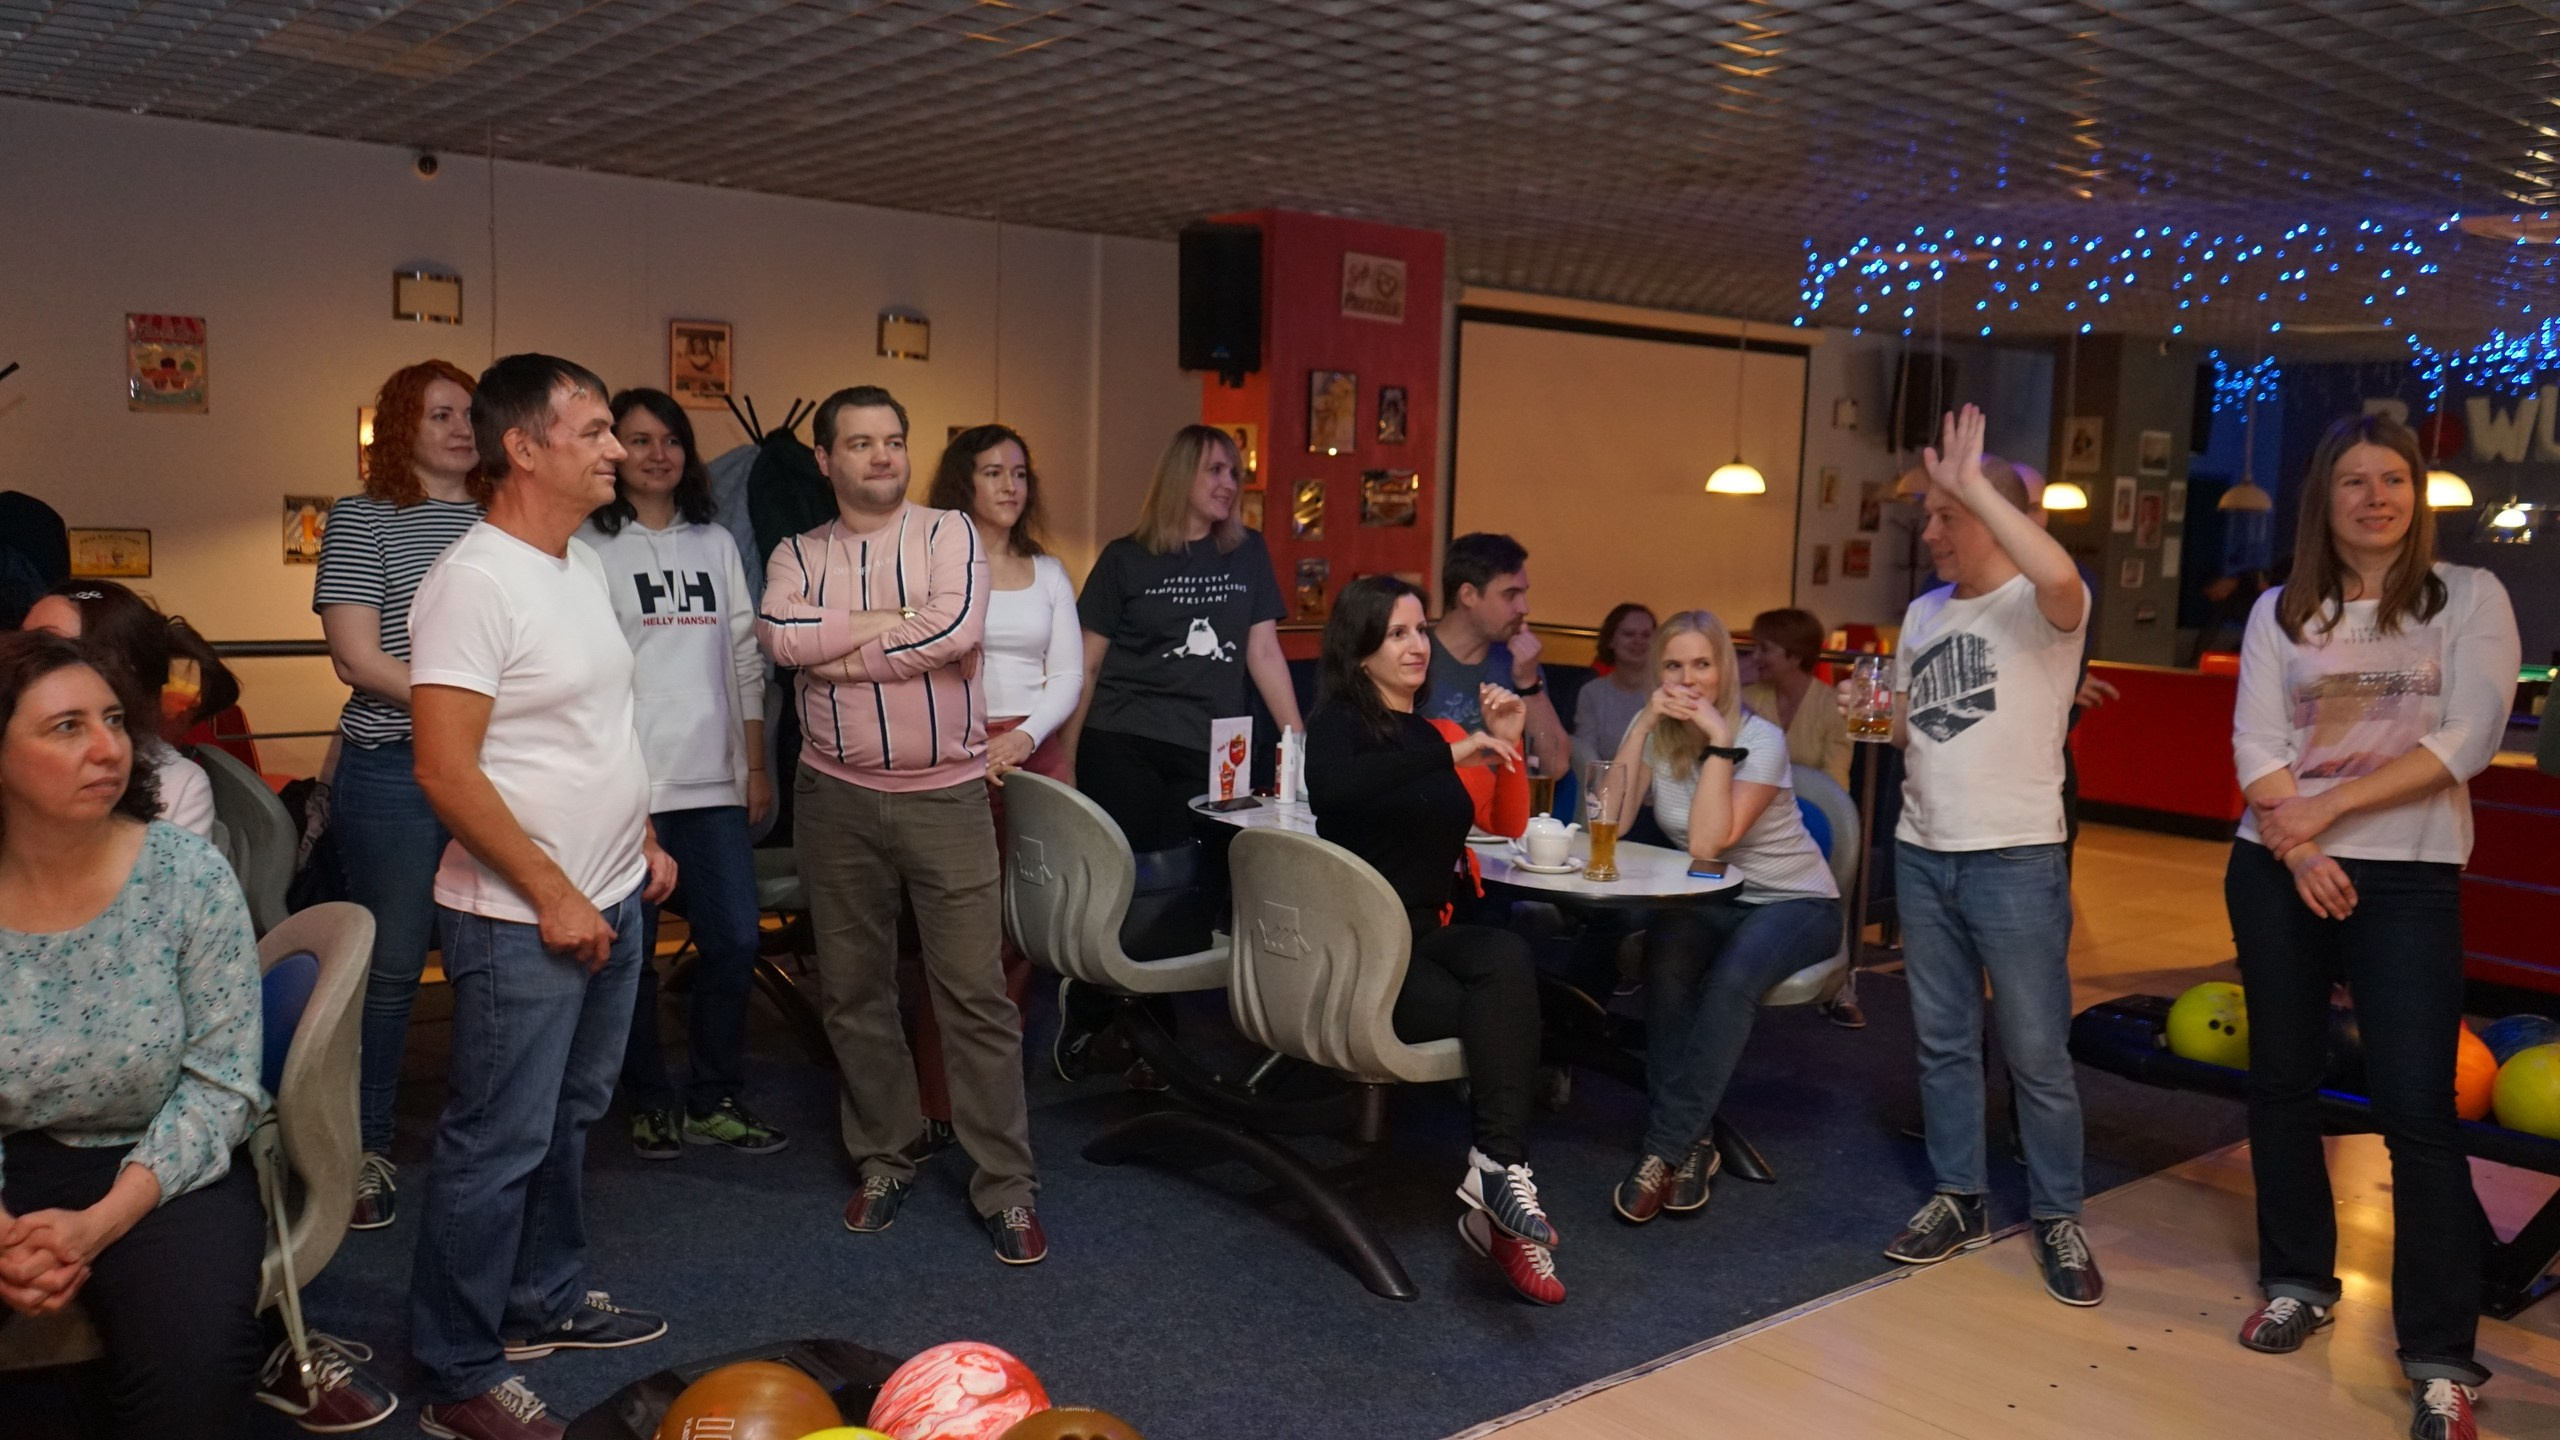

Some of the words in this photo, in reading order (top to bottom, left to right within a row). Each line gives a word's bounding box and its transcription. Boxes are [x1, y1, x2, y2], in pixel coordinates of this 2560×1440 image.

[1163, 574, 1230, 584] PURRFECTLY
[1144, 586, 1197, 595] PAMPERED
[1205, 583, 1247, 593] PRECIOUS
[1172, 593, 1228, 605] PERSIAN!
[643, 616, 674, 627] HELLY
[677, 615, 718, 625] HANSEN
